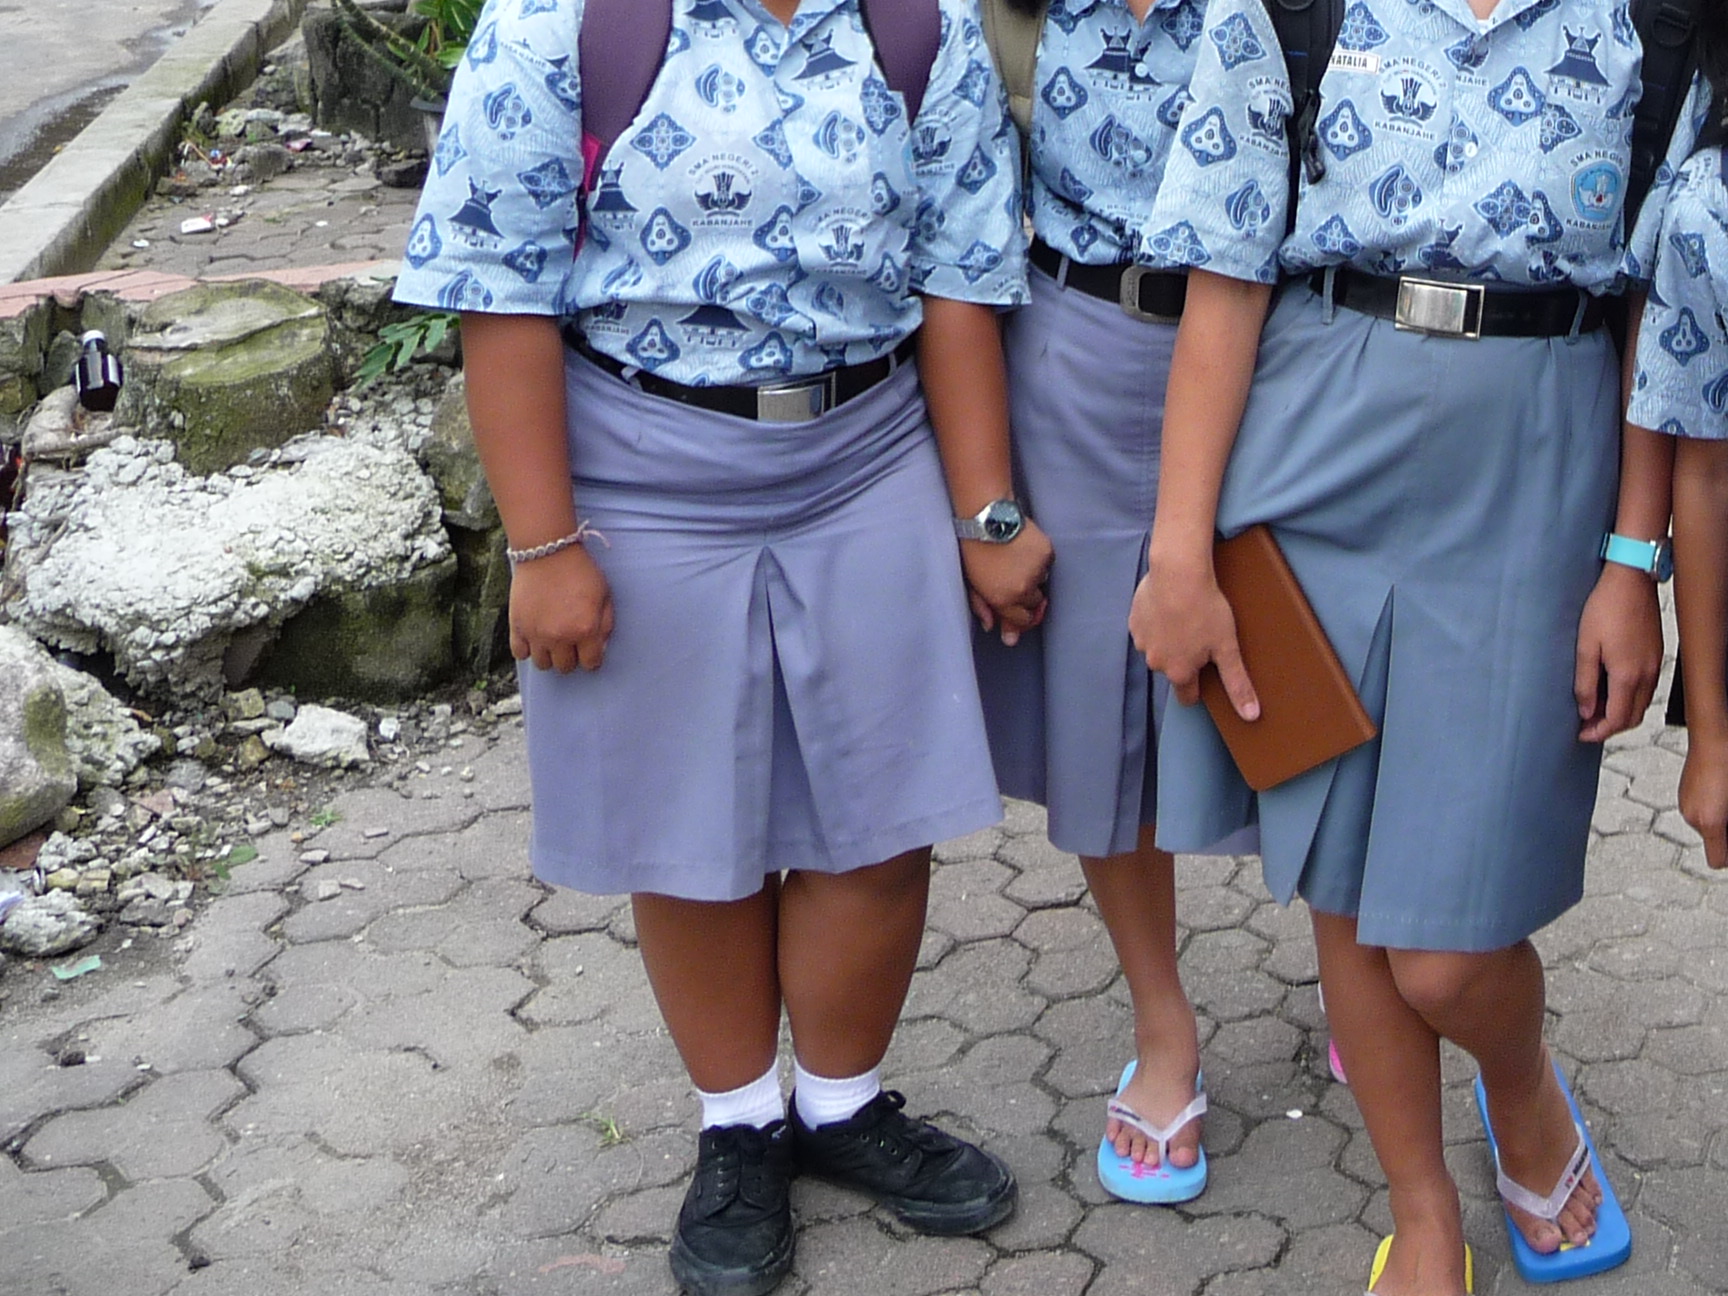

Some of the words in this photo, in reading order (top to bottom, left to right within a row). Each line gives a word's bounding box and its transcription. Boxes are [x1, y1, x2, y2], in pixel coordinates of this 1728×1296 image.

[1402, 57, 1442, 81] NEGERI
[1455, 74, 1488, 86] NJAHE
[1375, 120, 1435, 141] KABANJAHE
